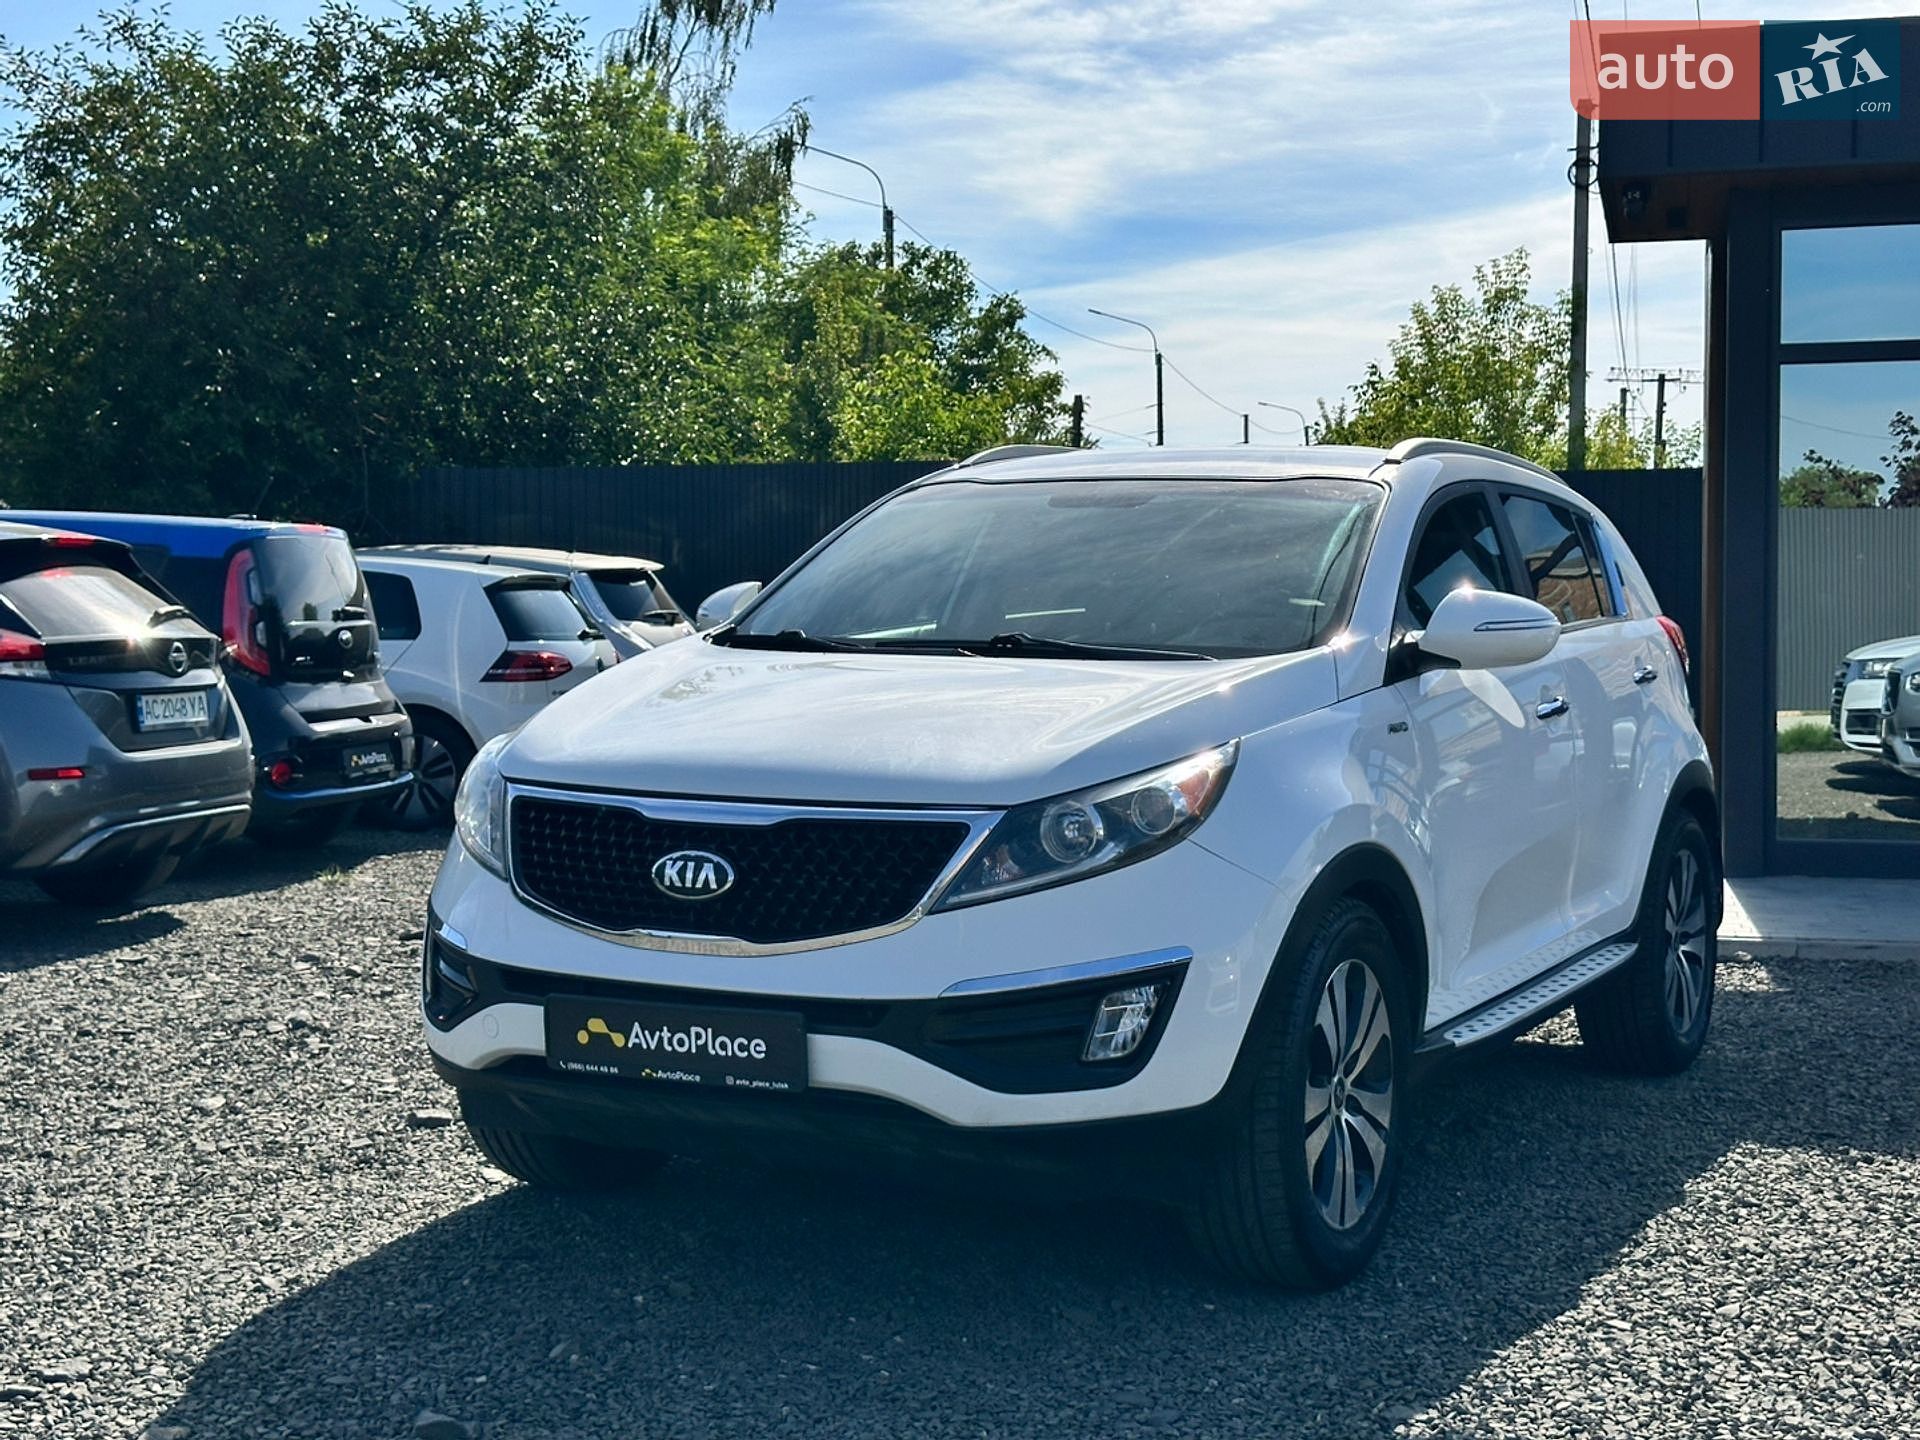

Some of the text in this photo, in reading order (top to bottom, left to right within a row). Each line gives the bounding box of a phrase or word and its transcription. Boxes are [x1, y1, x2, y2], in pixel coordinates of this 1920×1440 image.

[664, 860, 718, 889] KIA
[628, 1021, 767, 1060] AvtoPlace
[657, 1069, 701, 1083] AvtoPlace
